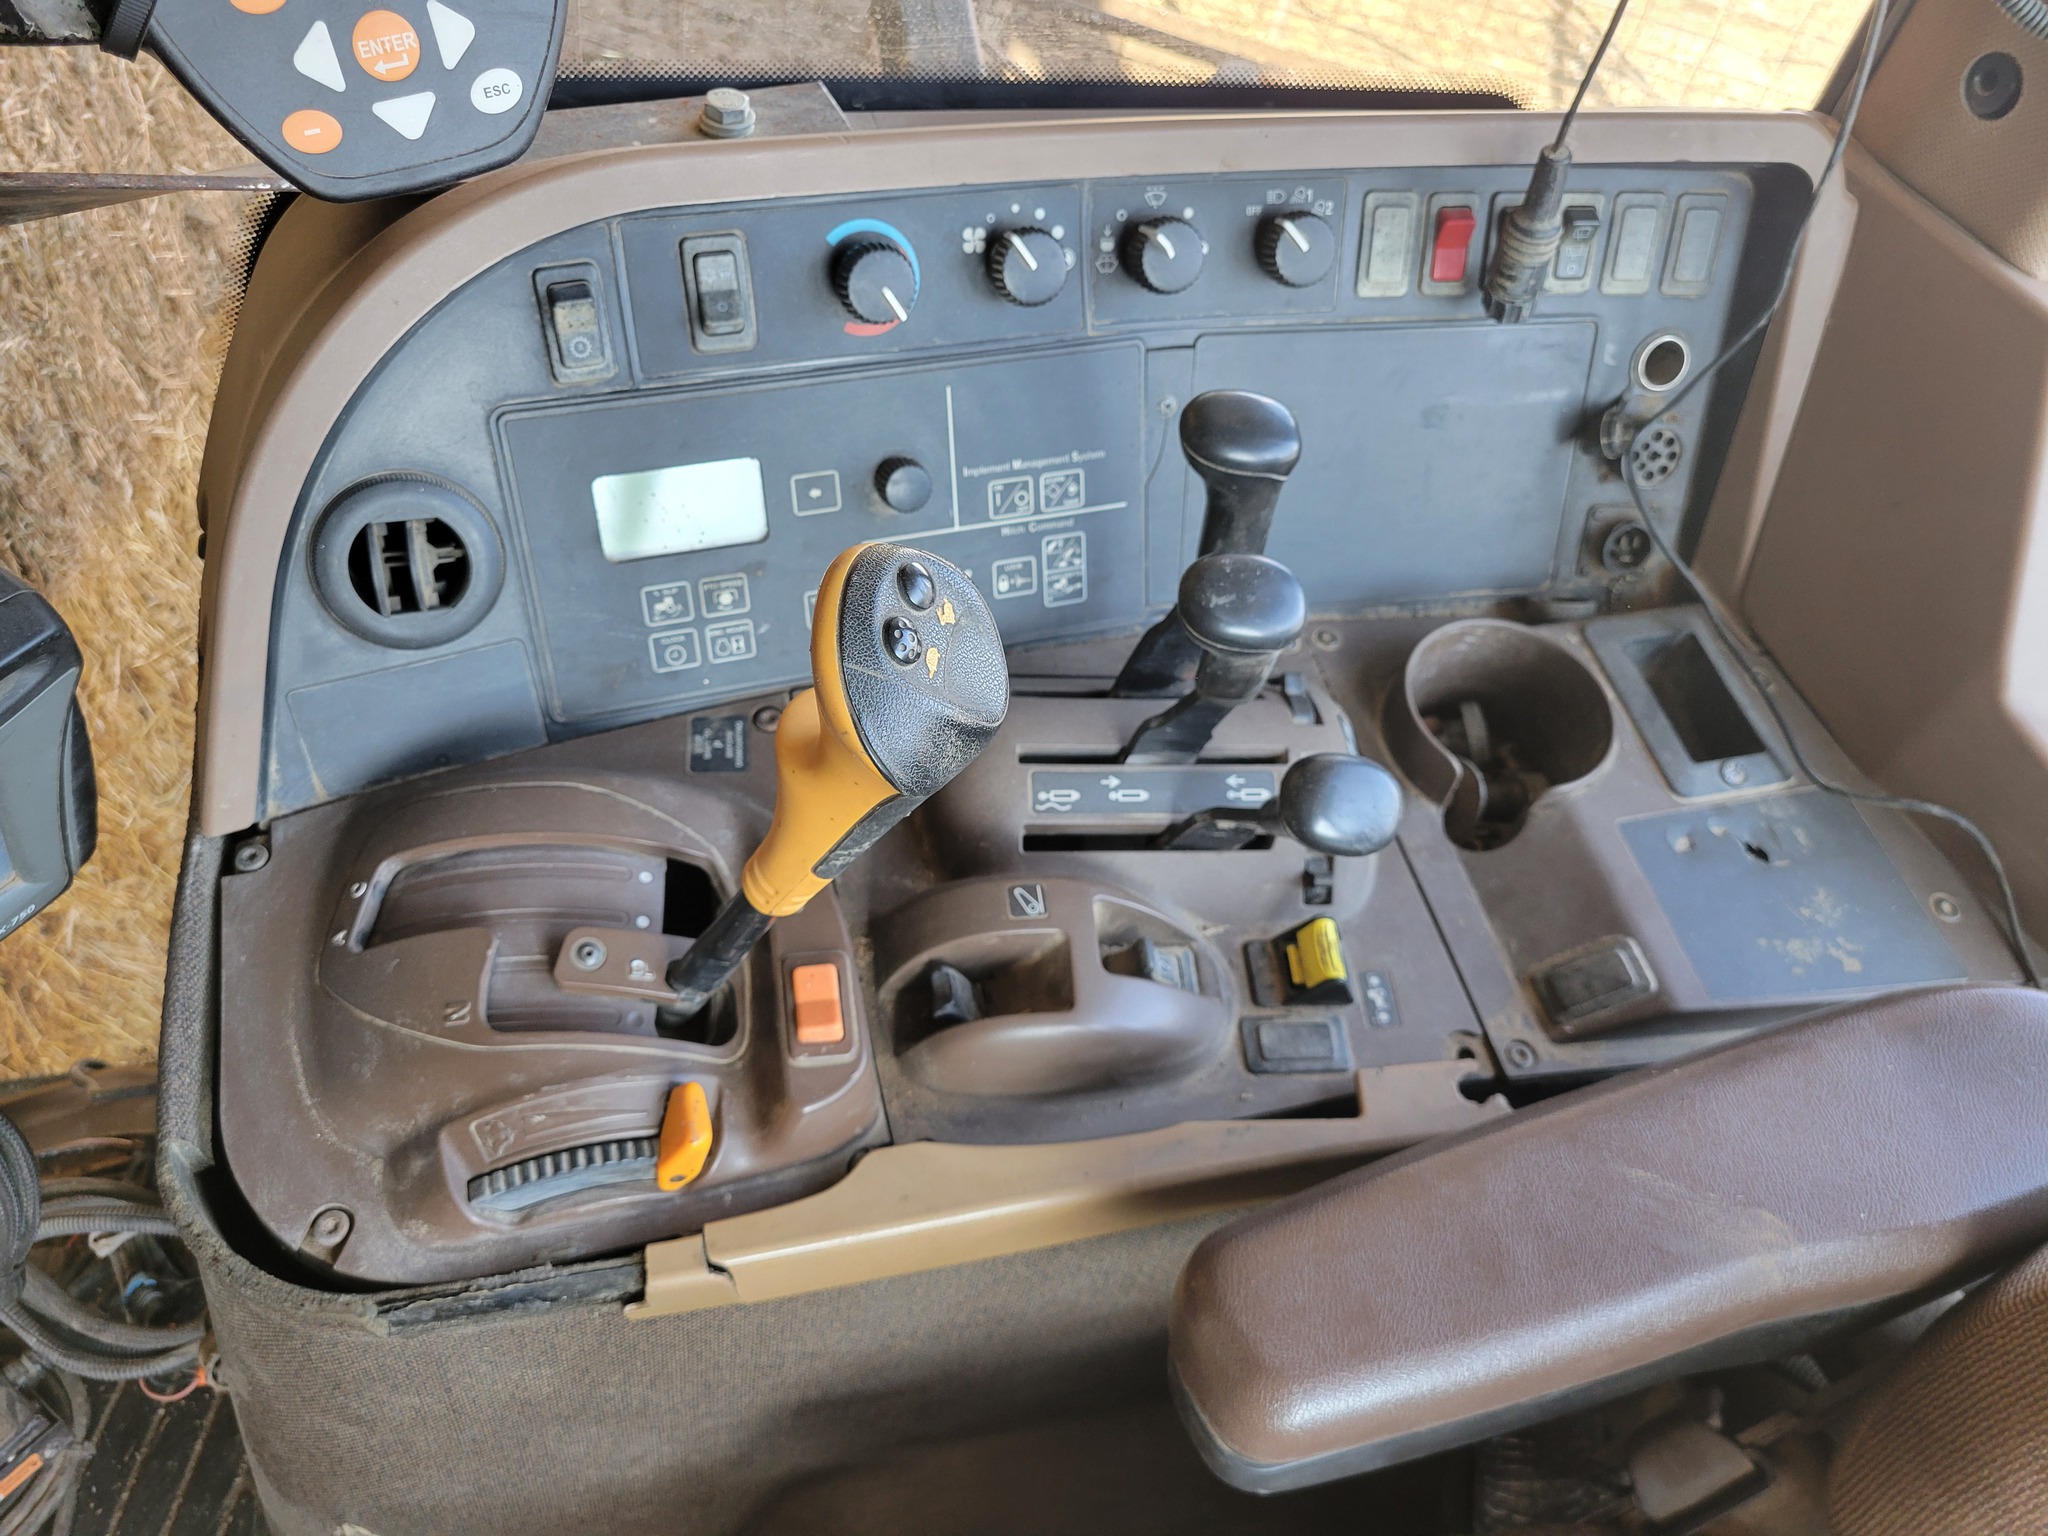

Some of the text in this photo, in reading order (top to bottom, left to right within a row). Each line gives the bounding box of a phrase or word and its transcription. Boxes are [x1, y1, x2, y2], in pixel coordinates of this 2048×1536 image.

[357, 31, 418, 59] ENTER
[483, 83, 511, 99] ESC
[1306, 188, 1314, 203] 1
[1245, 205, 1263, 217] OFF
[1324, 200, 1335, 216] 2
[962, 450, 1106, 478] Implement Management System
